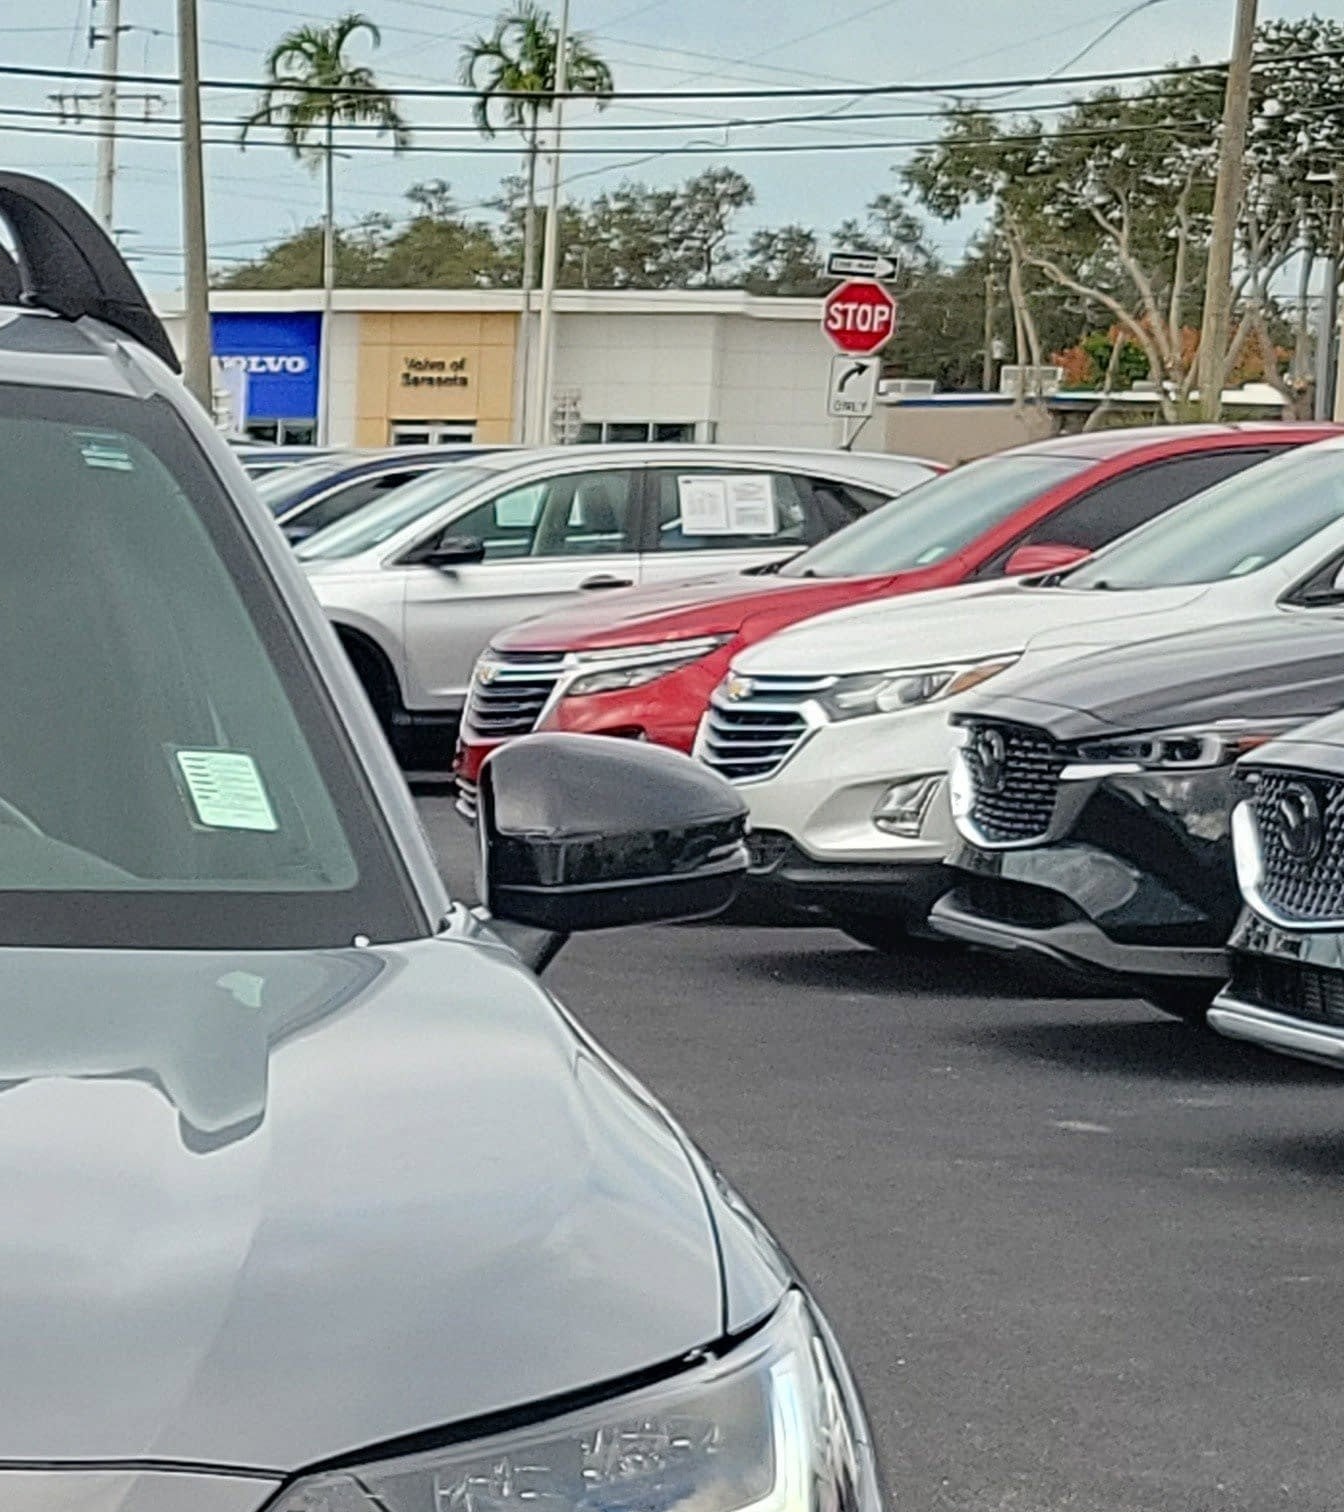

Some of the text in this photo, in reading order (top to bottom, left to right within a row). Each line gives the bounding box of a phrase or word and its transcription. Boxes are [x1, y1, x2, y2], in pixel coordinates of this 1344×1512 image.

[827, 302, 890, 332] STOP
[404, 357, 466, 371] Volvo of
[833, 399, 868, 412] ONLY
